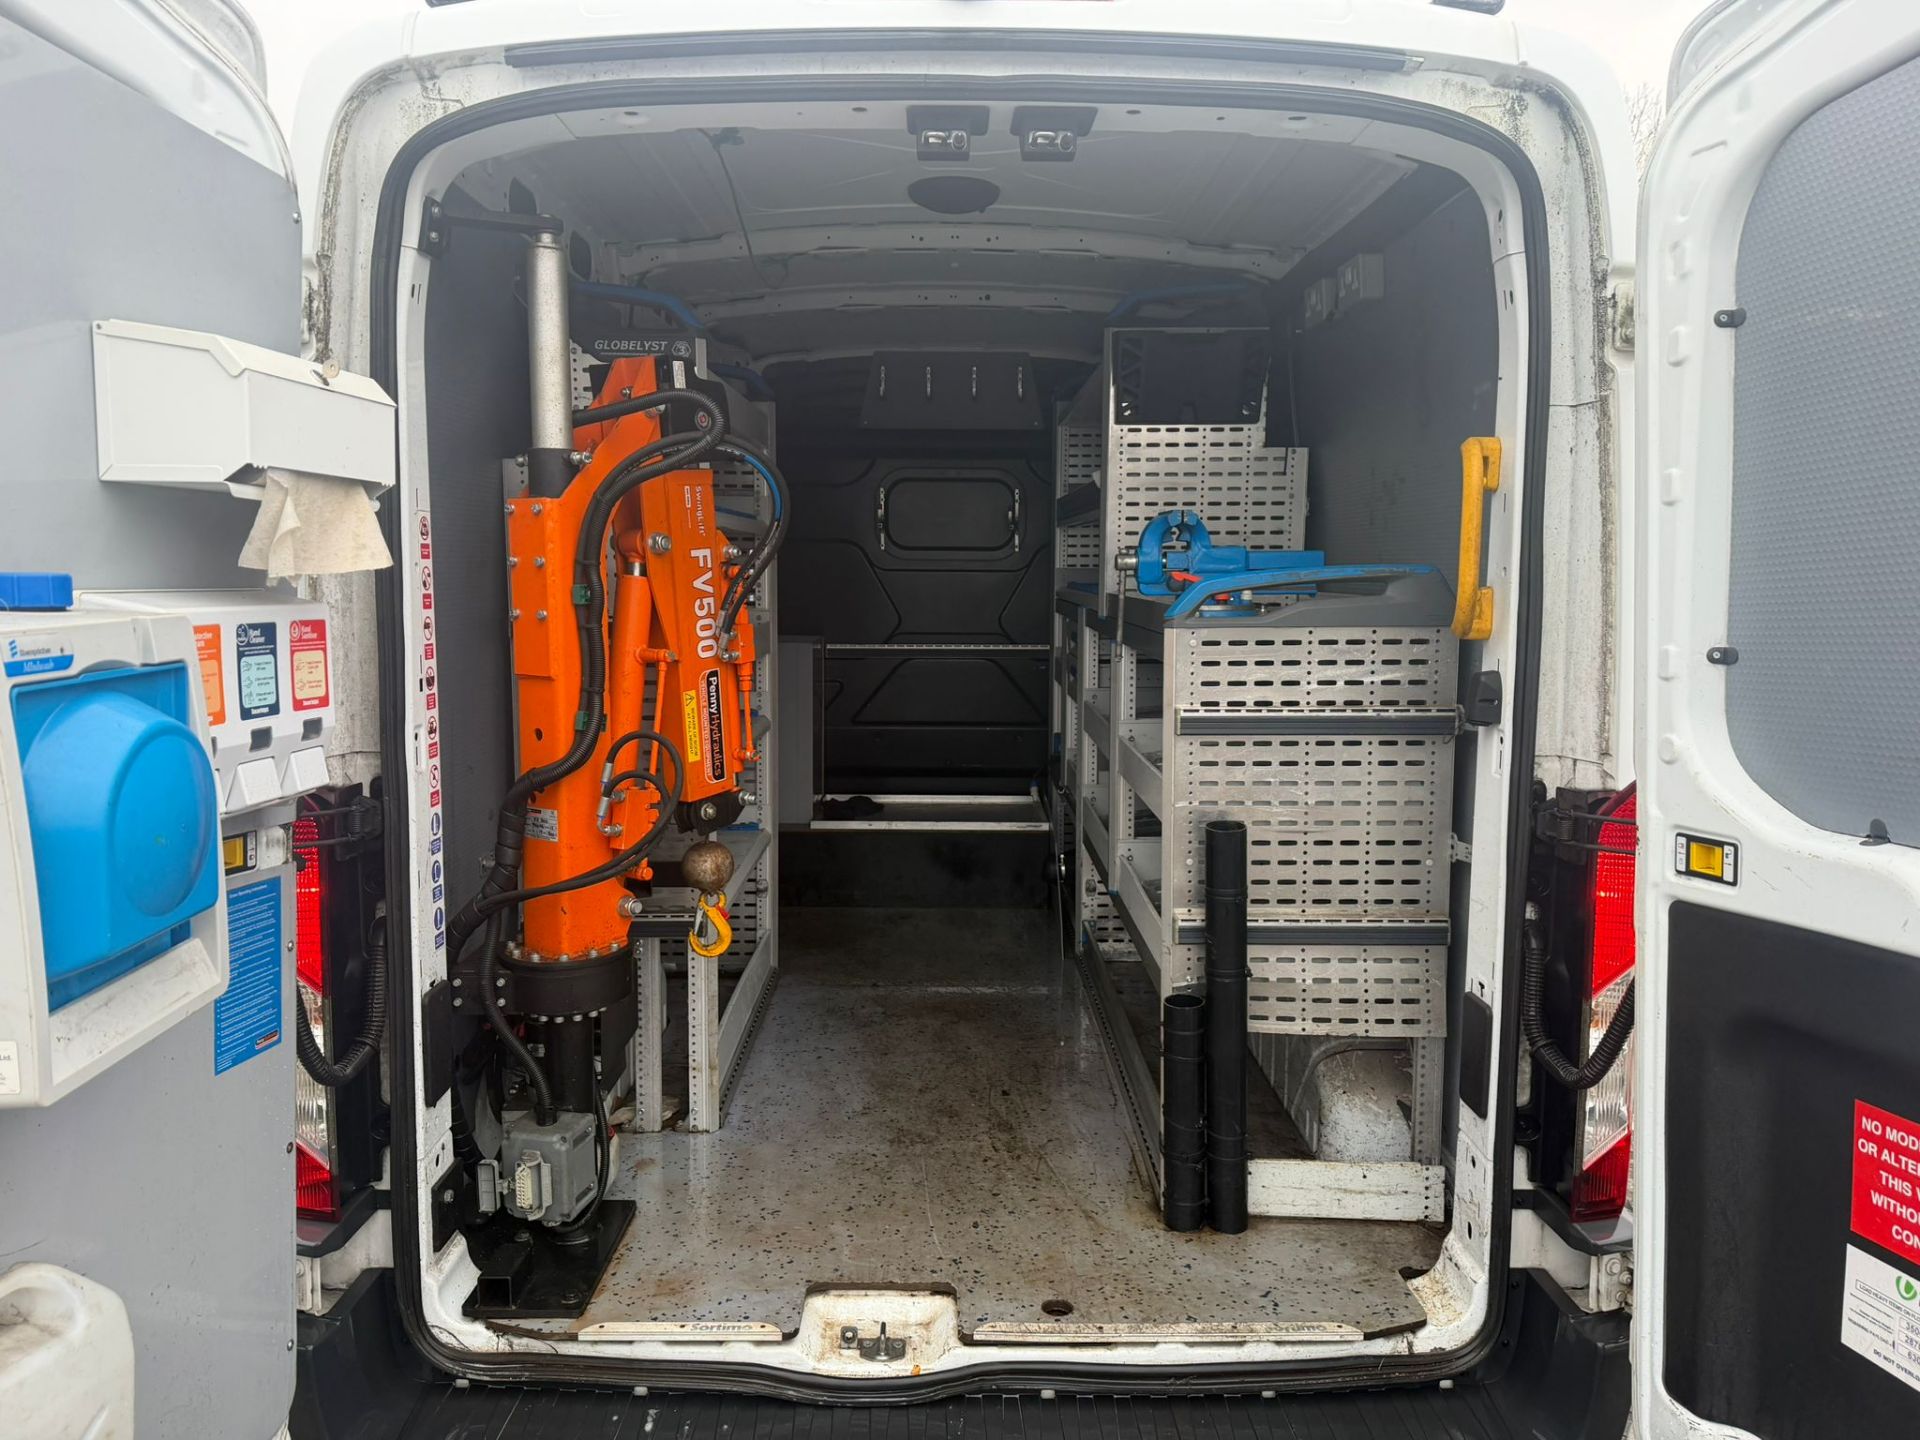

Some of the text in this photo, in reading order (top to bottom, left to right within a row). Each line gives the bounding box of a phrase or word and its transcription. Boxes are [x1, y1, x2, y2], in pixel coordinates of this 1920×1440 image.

[594, 340, 668, 351] GLOBELYST
[690, 548, 718, 659] FV500
[707, 676, 723, 776] Penny Hydraulics
[1861, 1116, 1882, 1136] NO
[1858, 1138, 1878, 1158] OR
[1879, 1170, 1913, 1198] THIS
[1859, 1283, 1872, 1295] LOAD
[1872, 1290, 1888, 1304] HEAVY
[690, 1323, 753, 1332] Sortimo
[1873, 1348, 1882, 1358] DO
[1883, 1354, 1895, 1366] NOT
